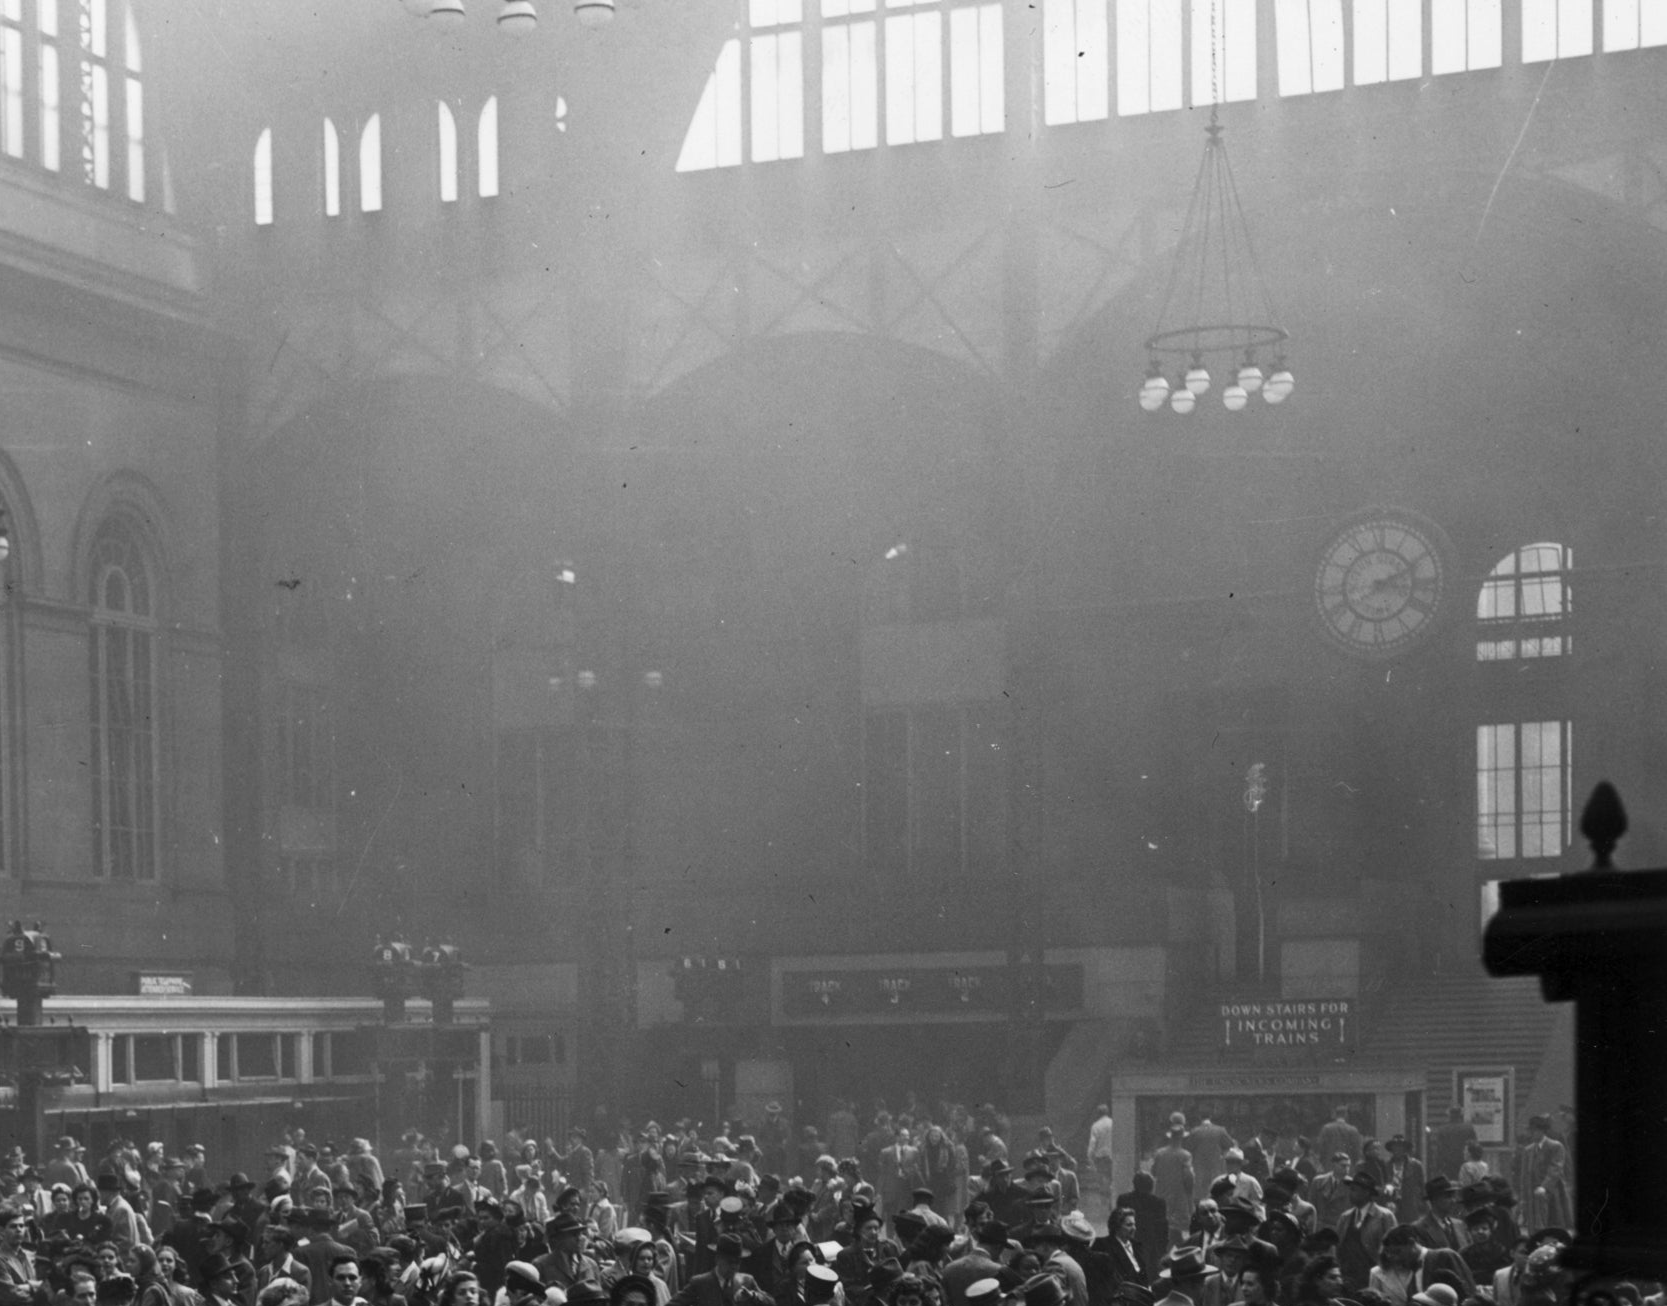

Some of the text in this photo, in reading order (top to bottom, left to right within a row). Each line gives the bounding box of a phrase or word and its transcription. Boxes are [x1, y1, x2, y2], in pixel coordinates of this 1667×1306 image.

[14, 939, 25, 952] 9
[1221, 1002, 1349, 1016] DOWN STAIRS FOR
[1238, 1018, 1332, 1032] INCOMING
[1253, 1032, 1320, 1045] TRAINS
